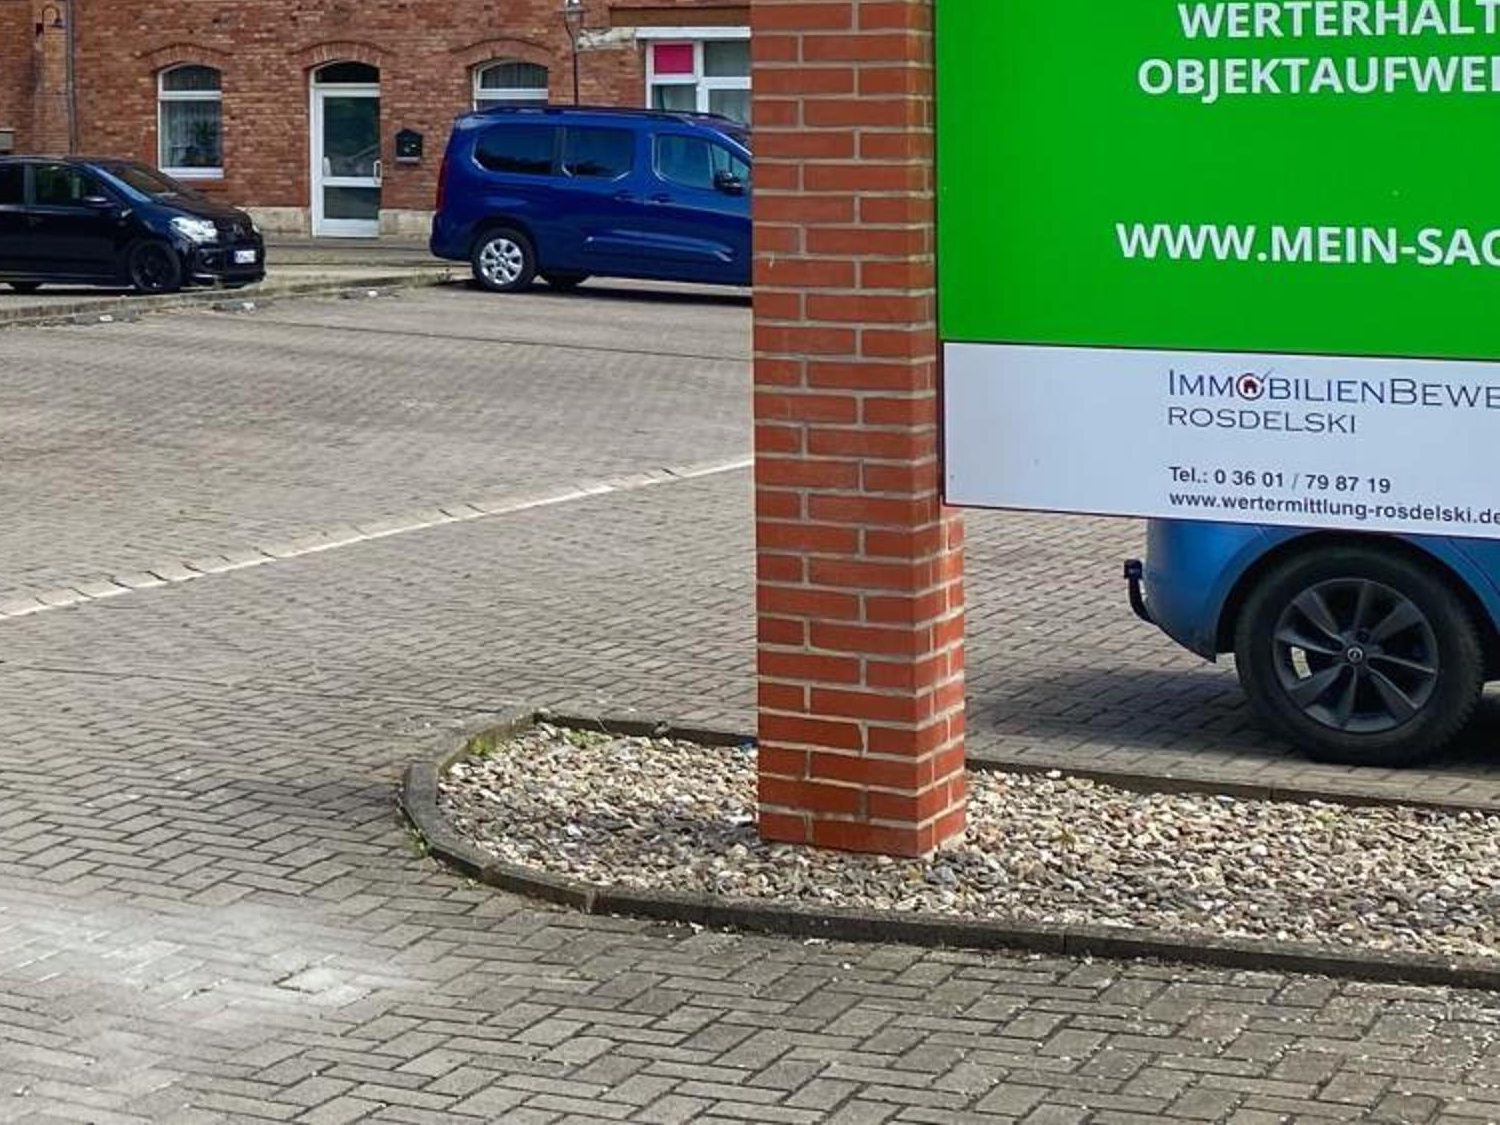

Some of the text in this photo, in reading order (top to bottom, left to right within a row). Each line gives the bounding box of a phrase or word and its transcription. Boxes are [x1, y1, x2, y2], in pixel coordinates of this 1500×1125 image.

[1167, 406, 1356, 435] ROSDELSKI
[1168, 466, 1208, 485] Tel.:
[1214, 469, 1227, 485] 0
[1232, 470, 1256, 486] 36
[1261, 471, 1284, 488] 01
[1305, 474, 1330, 490] 79
[1335, 475, 1359, 492] 87
[1367, 477, 1391, 494] 19
